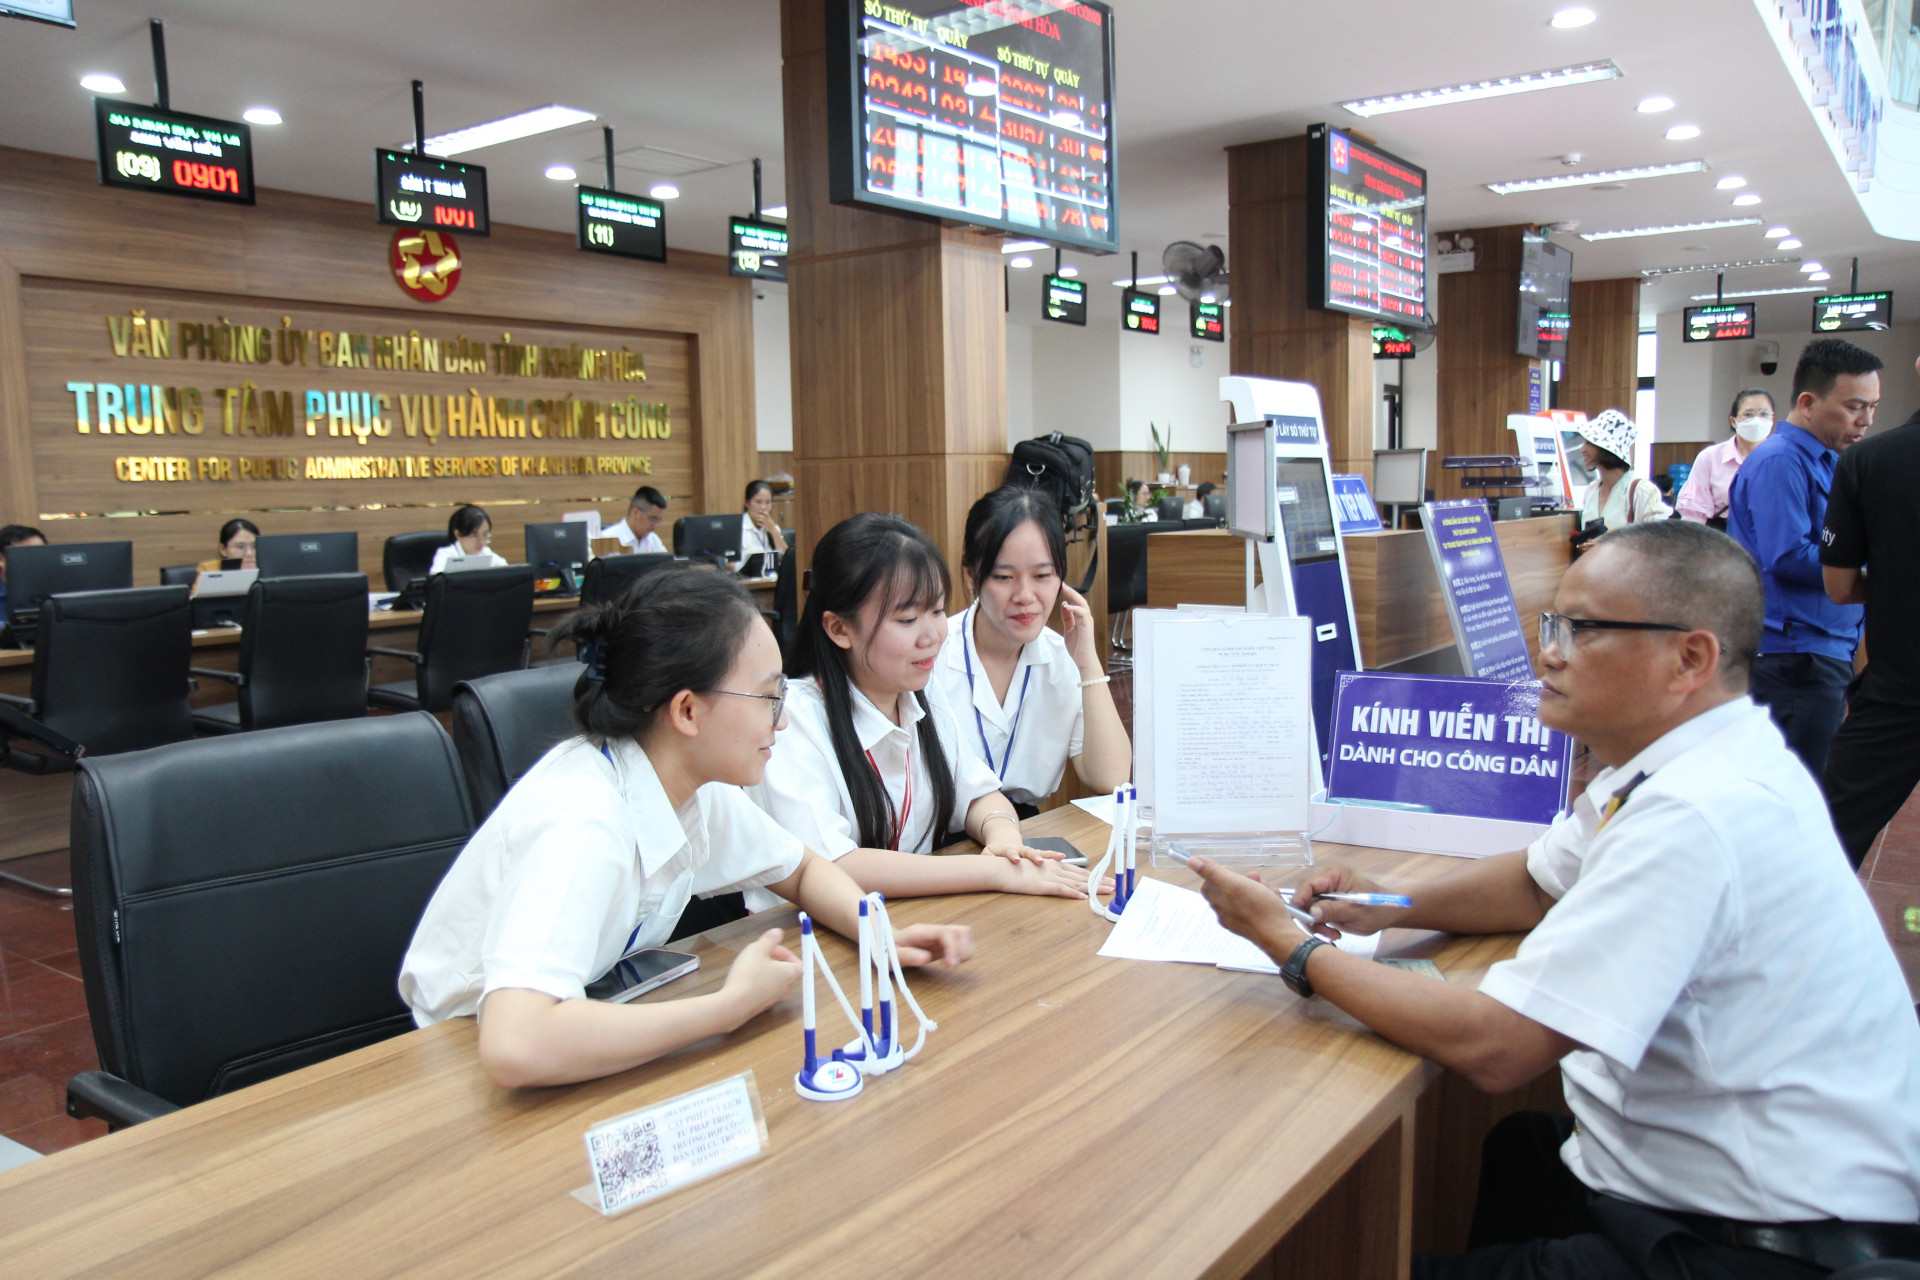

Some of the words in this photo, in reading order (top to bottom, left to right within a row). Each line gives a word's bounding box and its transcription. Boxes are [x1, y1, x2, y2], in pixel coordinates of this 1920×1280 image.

[1035, 16, 1061, 41] HÒA
[116, 151, 162, 182] (09)
[173, 160, 239, 194] 0901
[106, 309, 171, 358] VĂN
[178, 315, 271, 363] PHÒNG
[277, 316, 313, 366] ỦY
[318, 331, 370, 368] BAN
[373, 330, 439, 373] NHÂN
[442, 334, 486, 374] DÂN
[491, 332, 538, 376] TỈNH
[542, 342, 606, 380] KHÁNH
[611, 346, 647, 382] HÒA
[67, 381, 206, 435] TRUNG
[215, 380, 295, 436] TÂM
[305, 389, 393, 445] PHỤC
[399, 394, 442, 444] VỤ
[448, 387, 527, 438] HÀNH
[530, 392, 606, 439] CHÍNH
[610, 394, 672, 440] CÔNG
[115, 456, 191, 482] CENTER
[197, 456, 232, 481] FOR
[239, 456, 299, 481] PUBLIC
[304, 456, 430, 479] ADMINISTRATIVE
[433, 456, 497, 477] SERVICES
[501, 456, 519, 477] OF
[597, 456, 652, 476] PROVINCE
[1351, 701, 1419, 736] KÍNH
[1428, 703, 1495, 742] VIỄN
[1504, 715, 1550, 752] THỊ
[1340, 742, 1395, 764] DÀNH
[1400, 750, 1442, 769] CHO
[1446, 750, 1505, 774] CÔNG
[1510, 755, 1557, 778] DÂN
